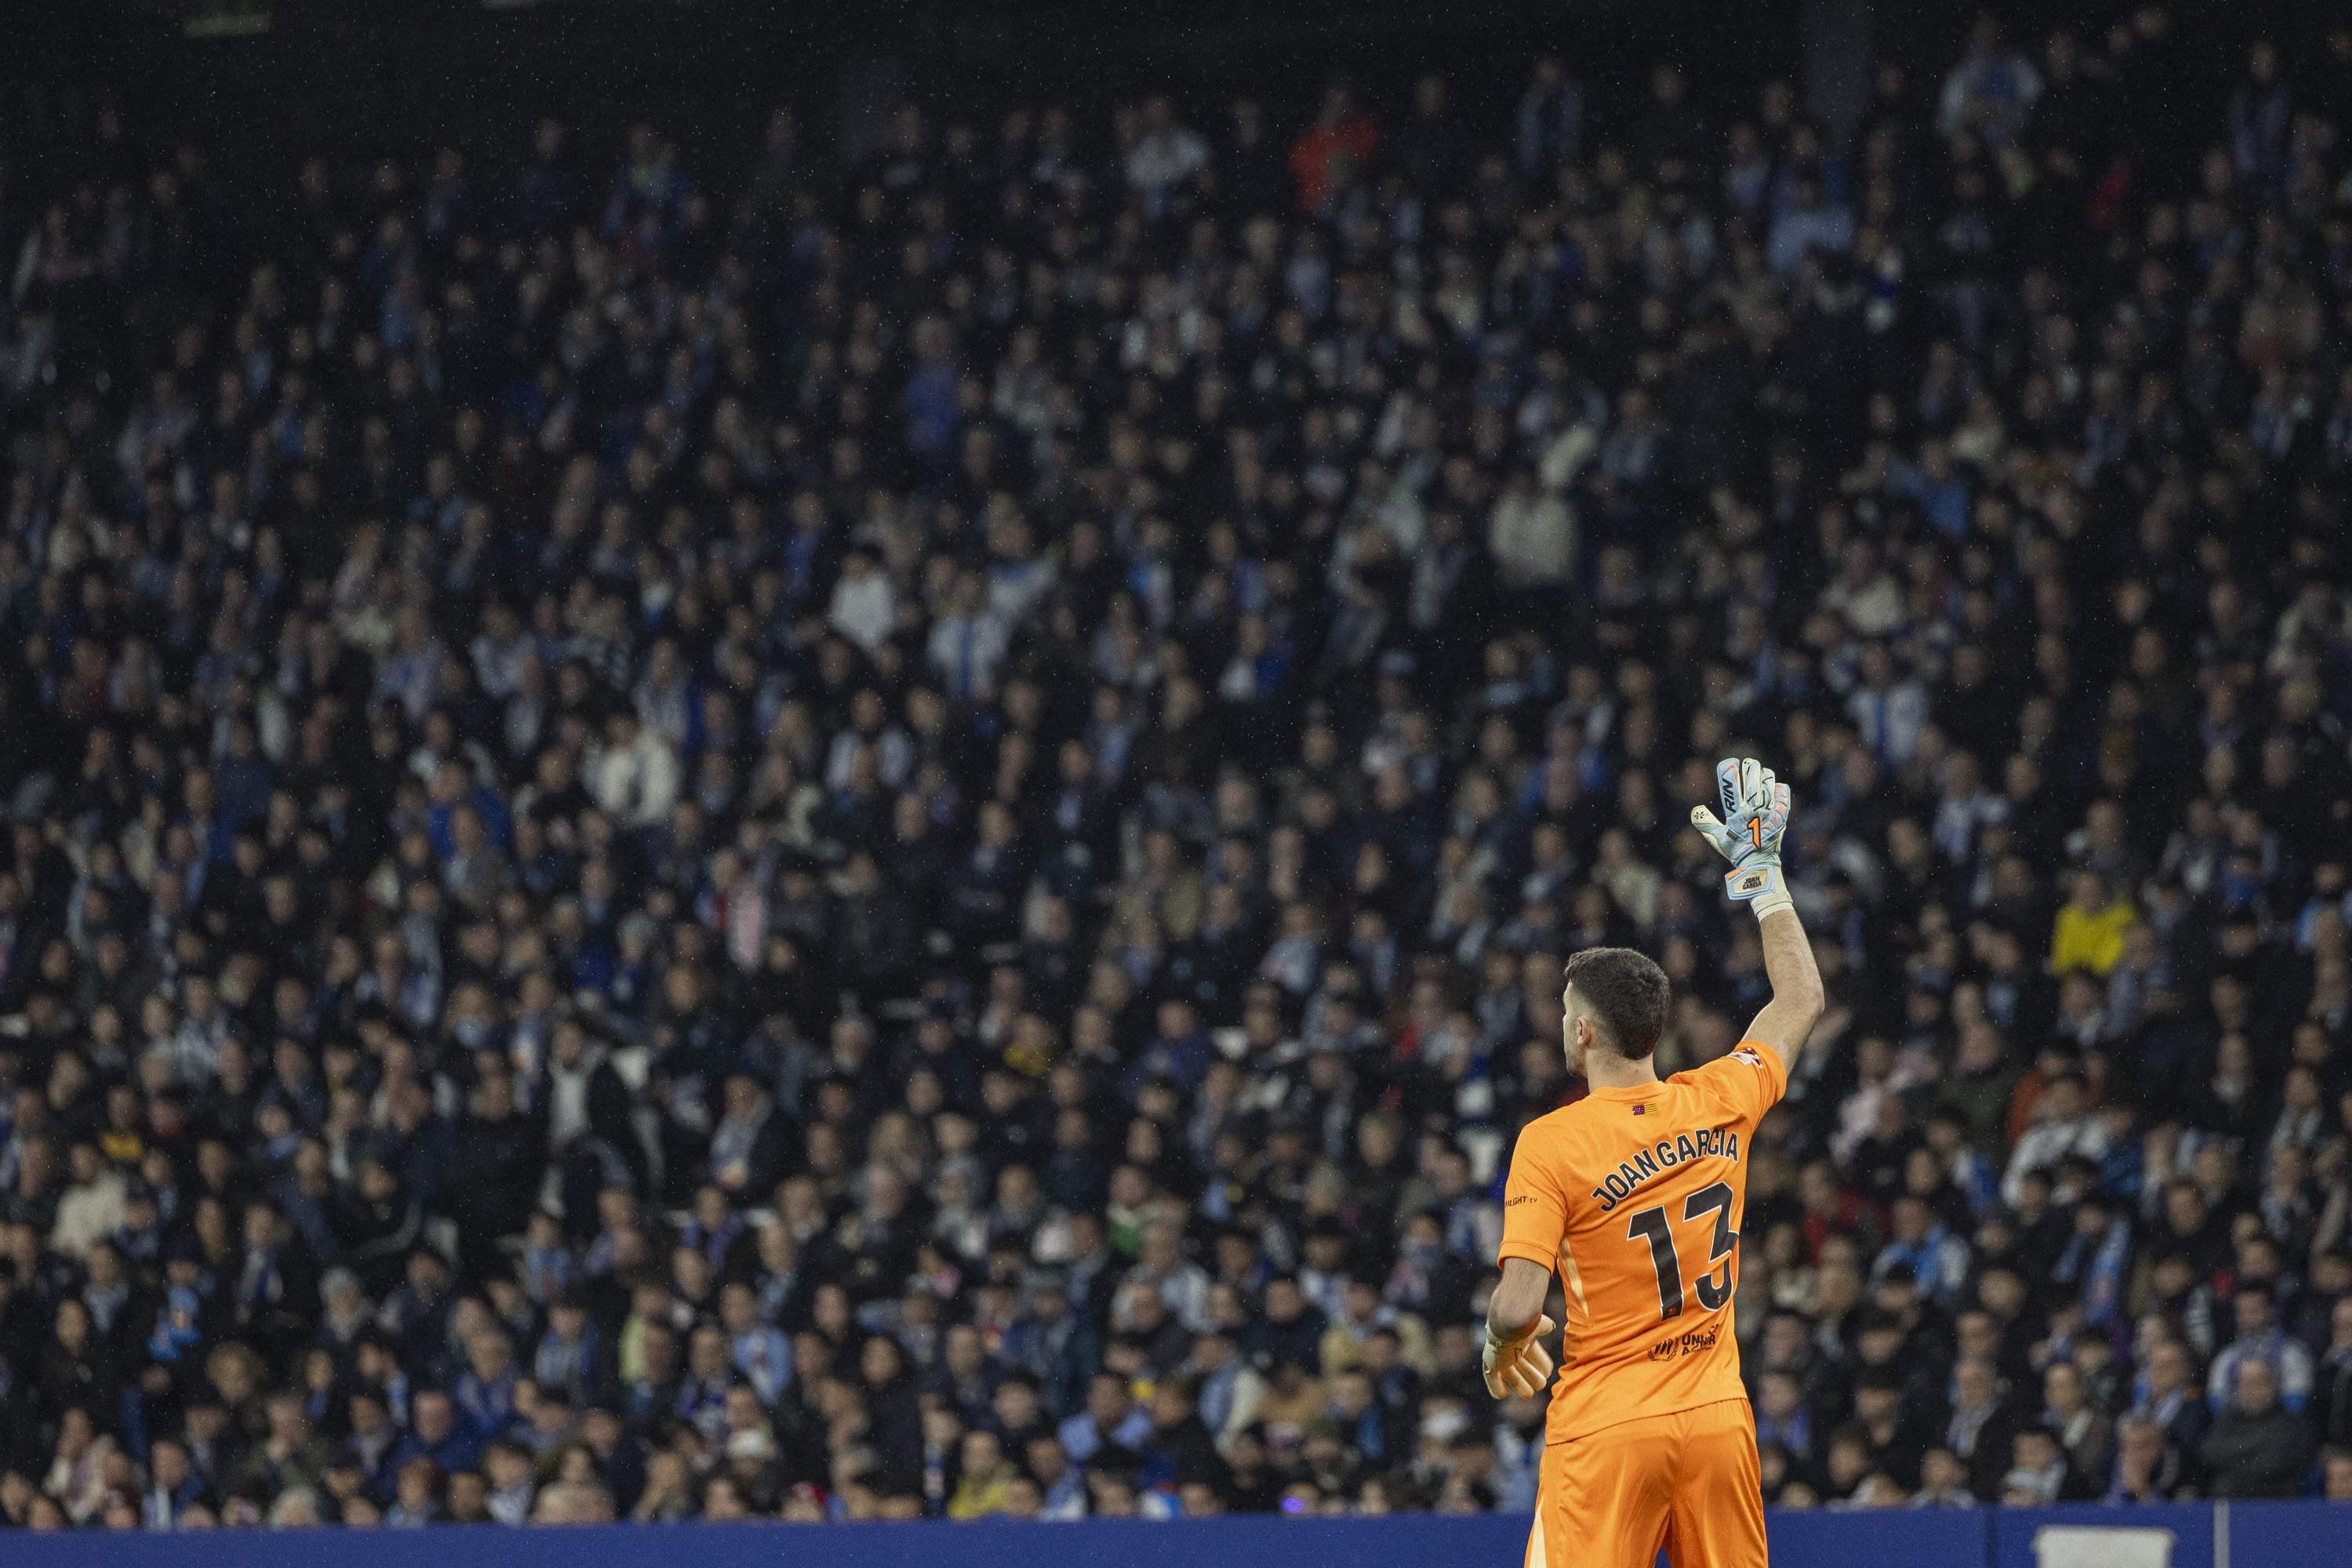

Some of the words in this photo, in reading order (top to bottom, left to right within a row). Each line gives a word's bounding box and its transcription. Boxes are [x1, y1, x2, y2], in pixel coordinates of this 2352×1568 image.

[1747, 816, 1761, 851] 1
[1744, 875, 1760, 884] JOAN
[1592, 1149, 1661, 1212] JOAN
[1655, 1128, 1739, 1167] GARCIA
[1627, 1181, 1740, 1322] 13
